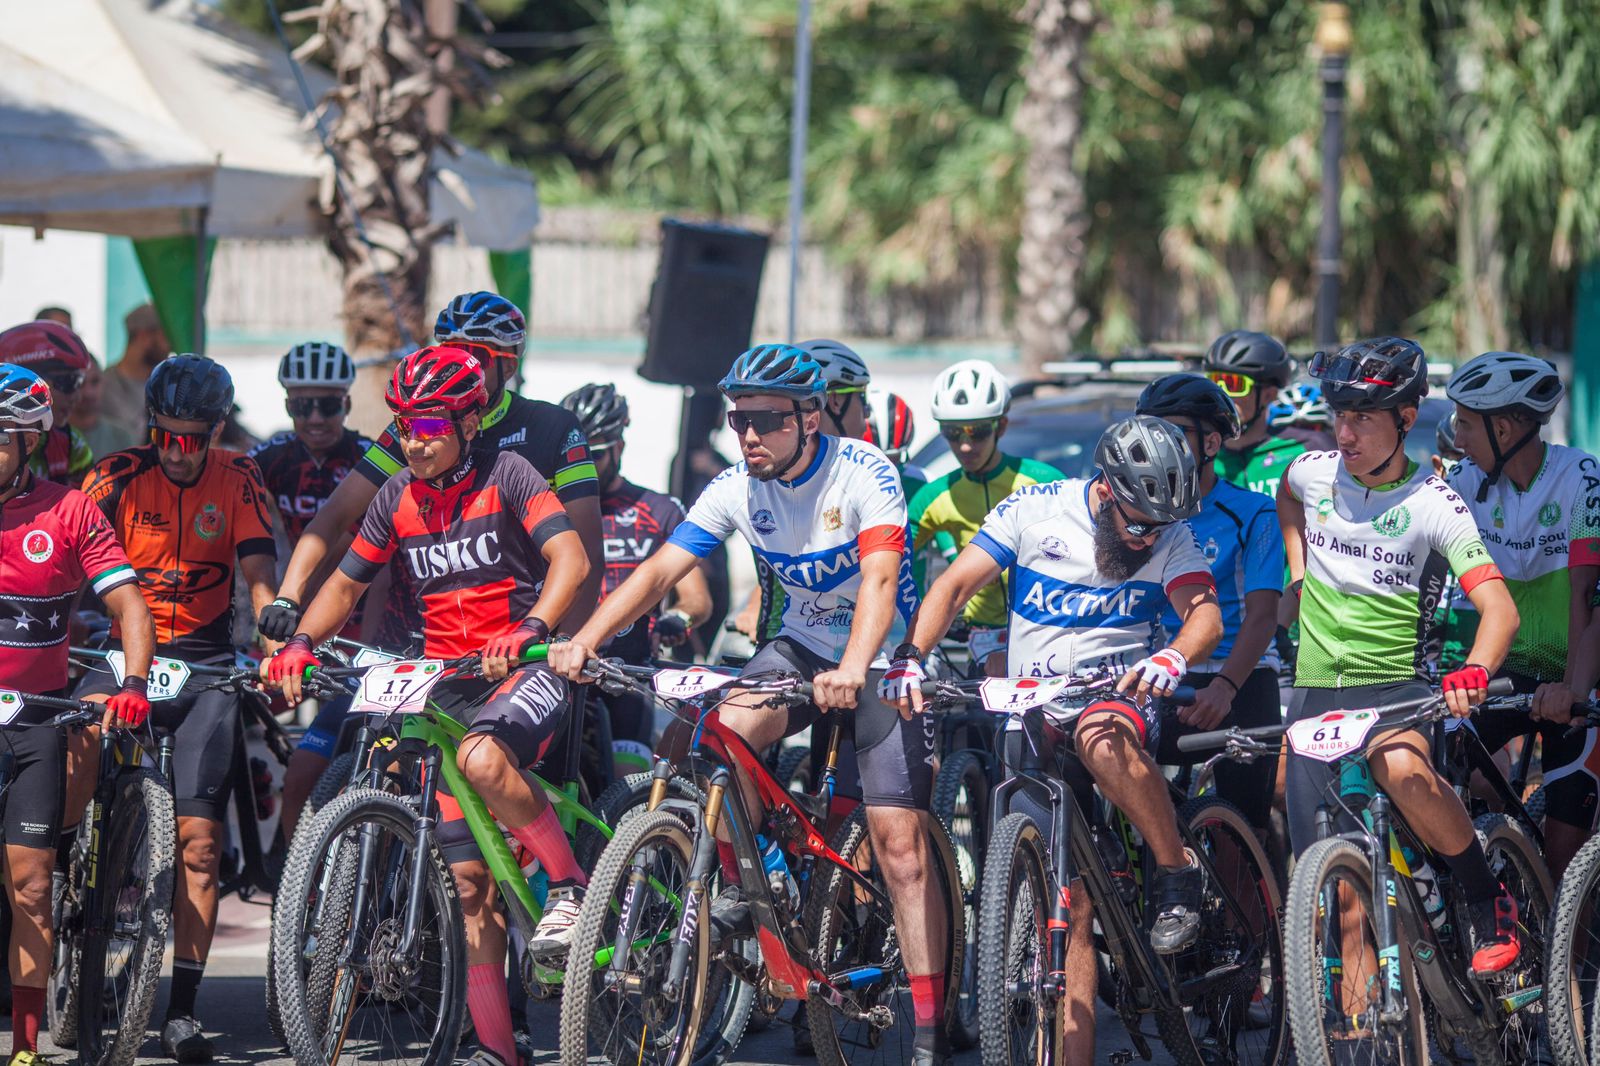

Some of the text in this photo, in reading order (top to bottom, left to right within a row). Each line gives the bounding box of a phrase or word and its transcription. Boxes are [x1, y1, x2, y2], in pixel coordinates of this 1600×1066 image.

[452, 455, 474, 483] USKC
[837, 443, 899, 498] ACCTMF
[1425, 475, 1469, 515] CASS
[1579, 457, 1600, 528] CASS
[1330, 537, 1367, 559] Amal
[1372, 546, 1416, 566] Souk
[1478, 529, 1502, 545] Club
[1538, 530, 1567, 546] Sou
[407, 530, 502, 580] USKC
[759, 548, 860, 589] CCTMF
[1372, 569, 1411, 586] Sebt
[1022, 581, 1147, 618] ACCTMF
[382, 679, 413, 695] 17
[676, 675, 705, 686] 11
[377, 694, 410, 702] ELITES
[510, 669, 564, 726] USKC
[1007, 692, 1037, 704] 14
[1304, 741, 1351, 751] JUNIORS
[1312, 725, 1342, 742] 61
[679, 890, 698, 946] FOX
